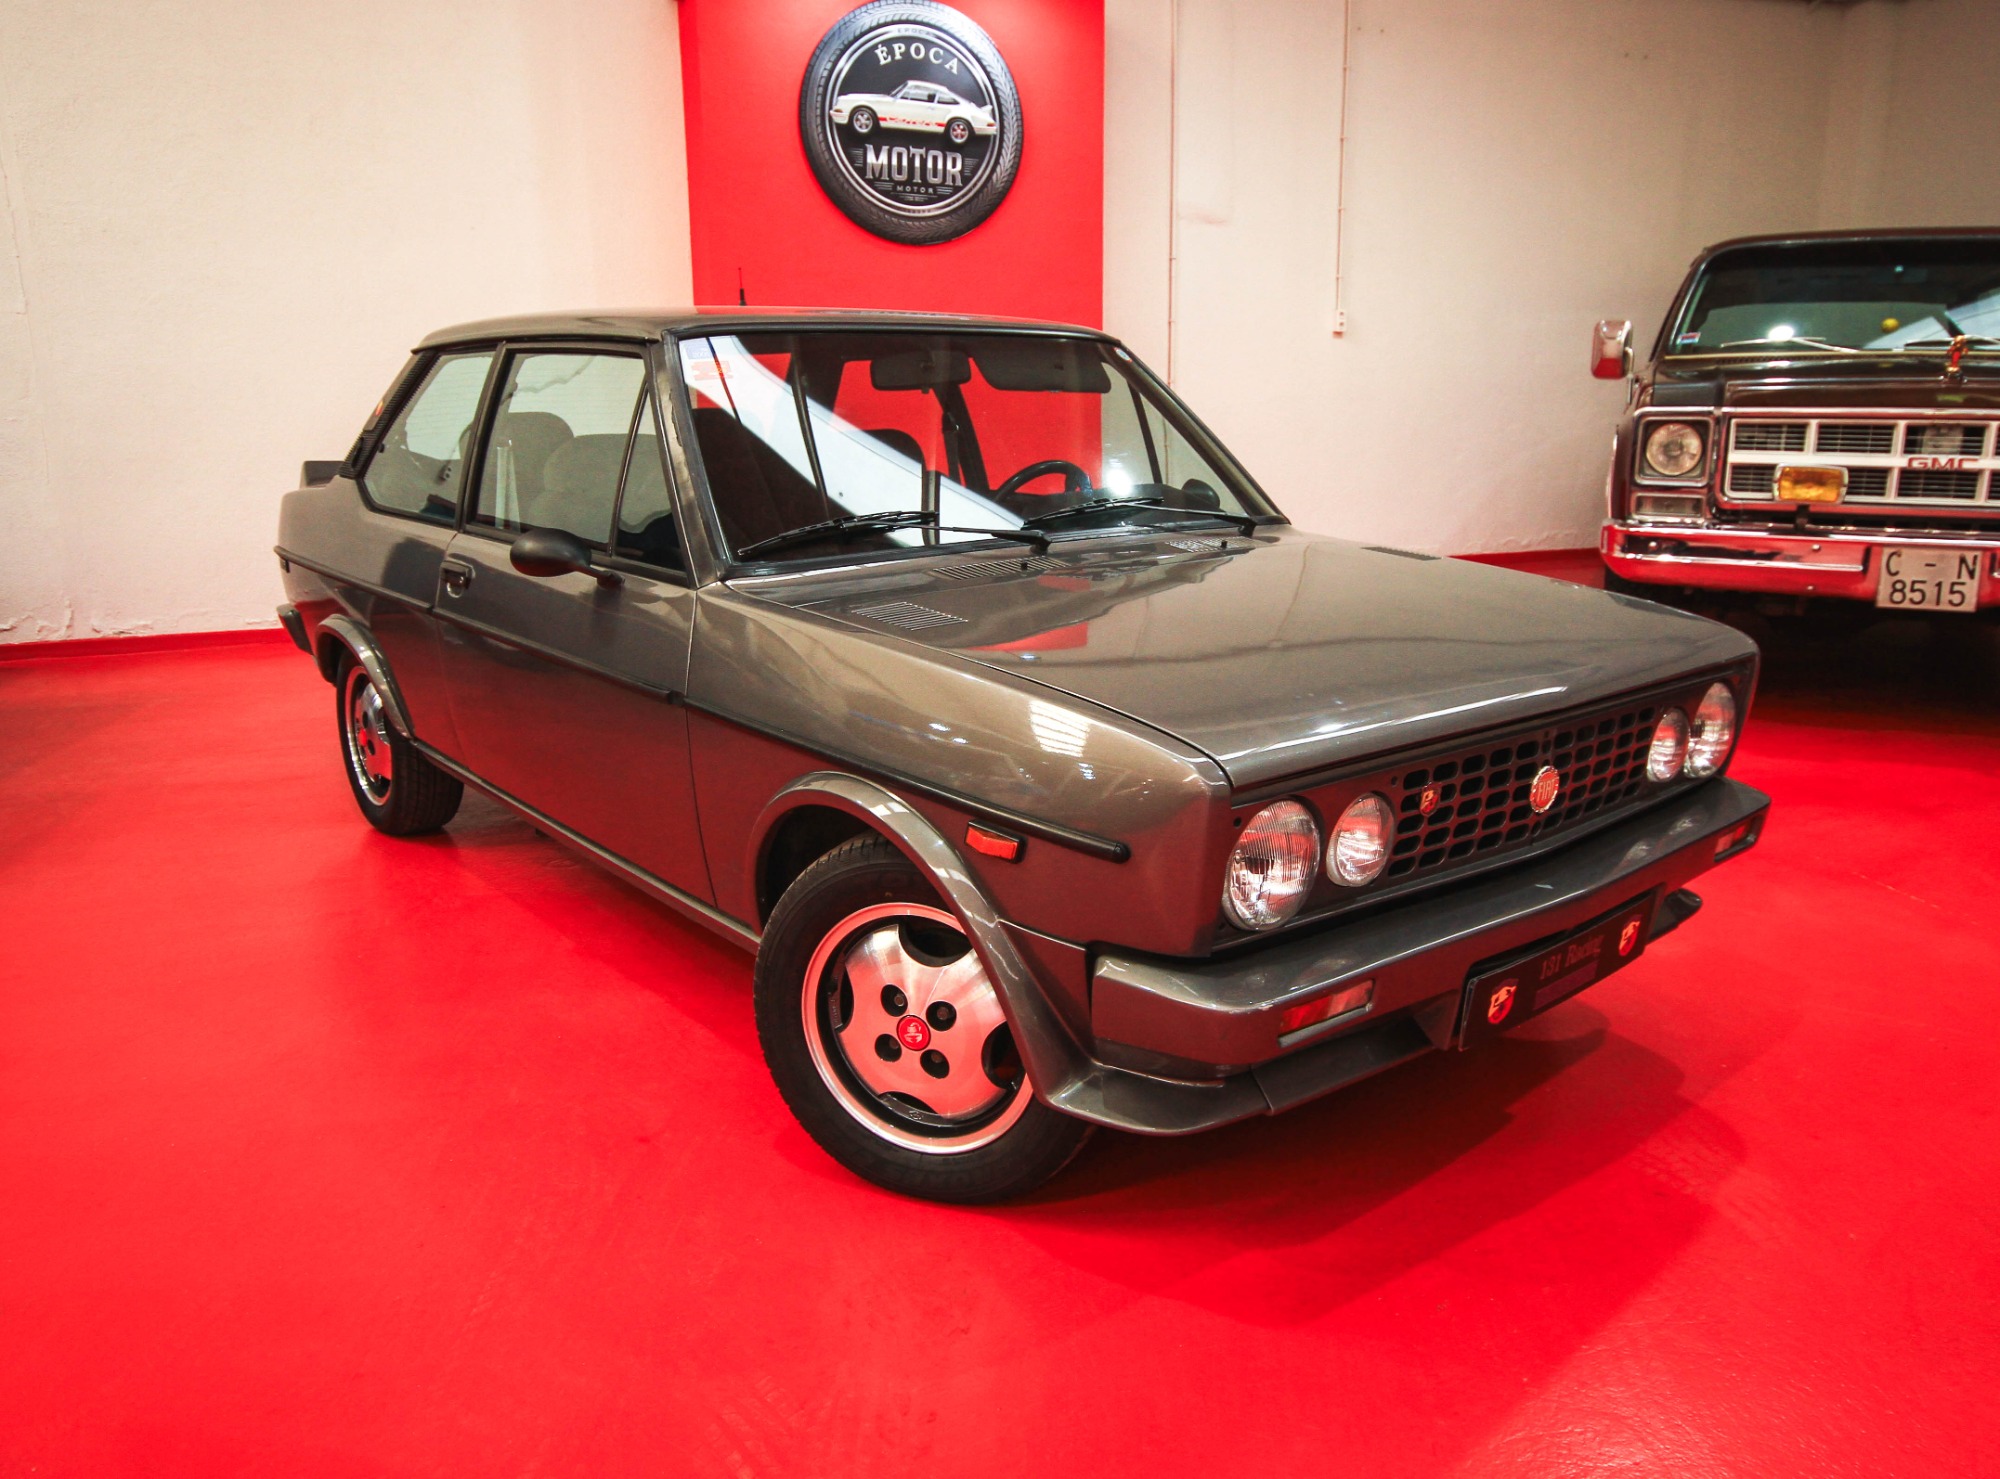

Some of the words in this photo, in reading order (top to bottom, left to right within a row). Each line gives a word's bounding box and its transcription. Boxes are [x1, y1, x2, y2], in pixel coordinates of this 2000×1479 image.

[875, 42, 959, 75] ÉPOCA
[865, 143, 963, 187] MOTOR
[896, 185, 934, 194] MOTOR
[1907, 457, 1980, 471] GMC
[1886, 551, 1902, 577] C
[1957, 554, 1978, 580] N
[1889, 579, 1967, 607] 8515
[1537, 777, 1557, 801] FIAT
[1540, 953, 1562, 980] 131
